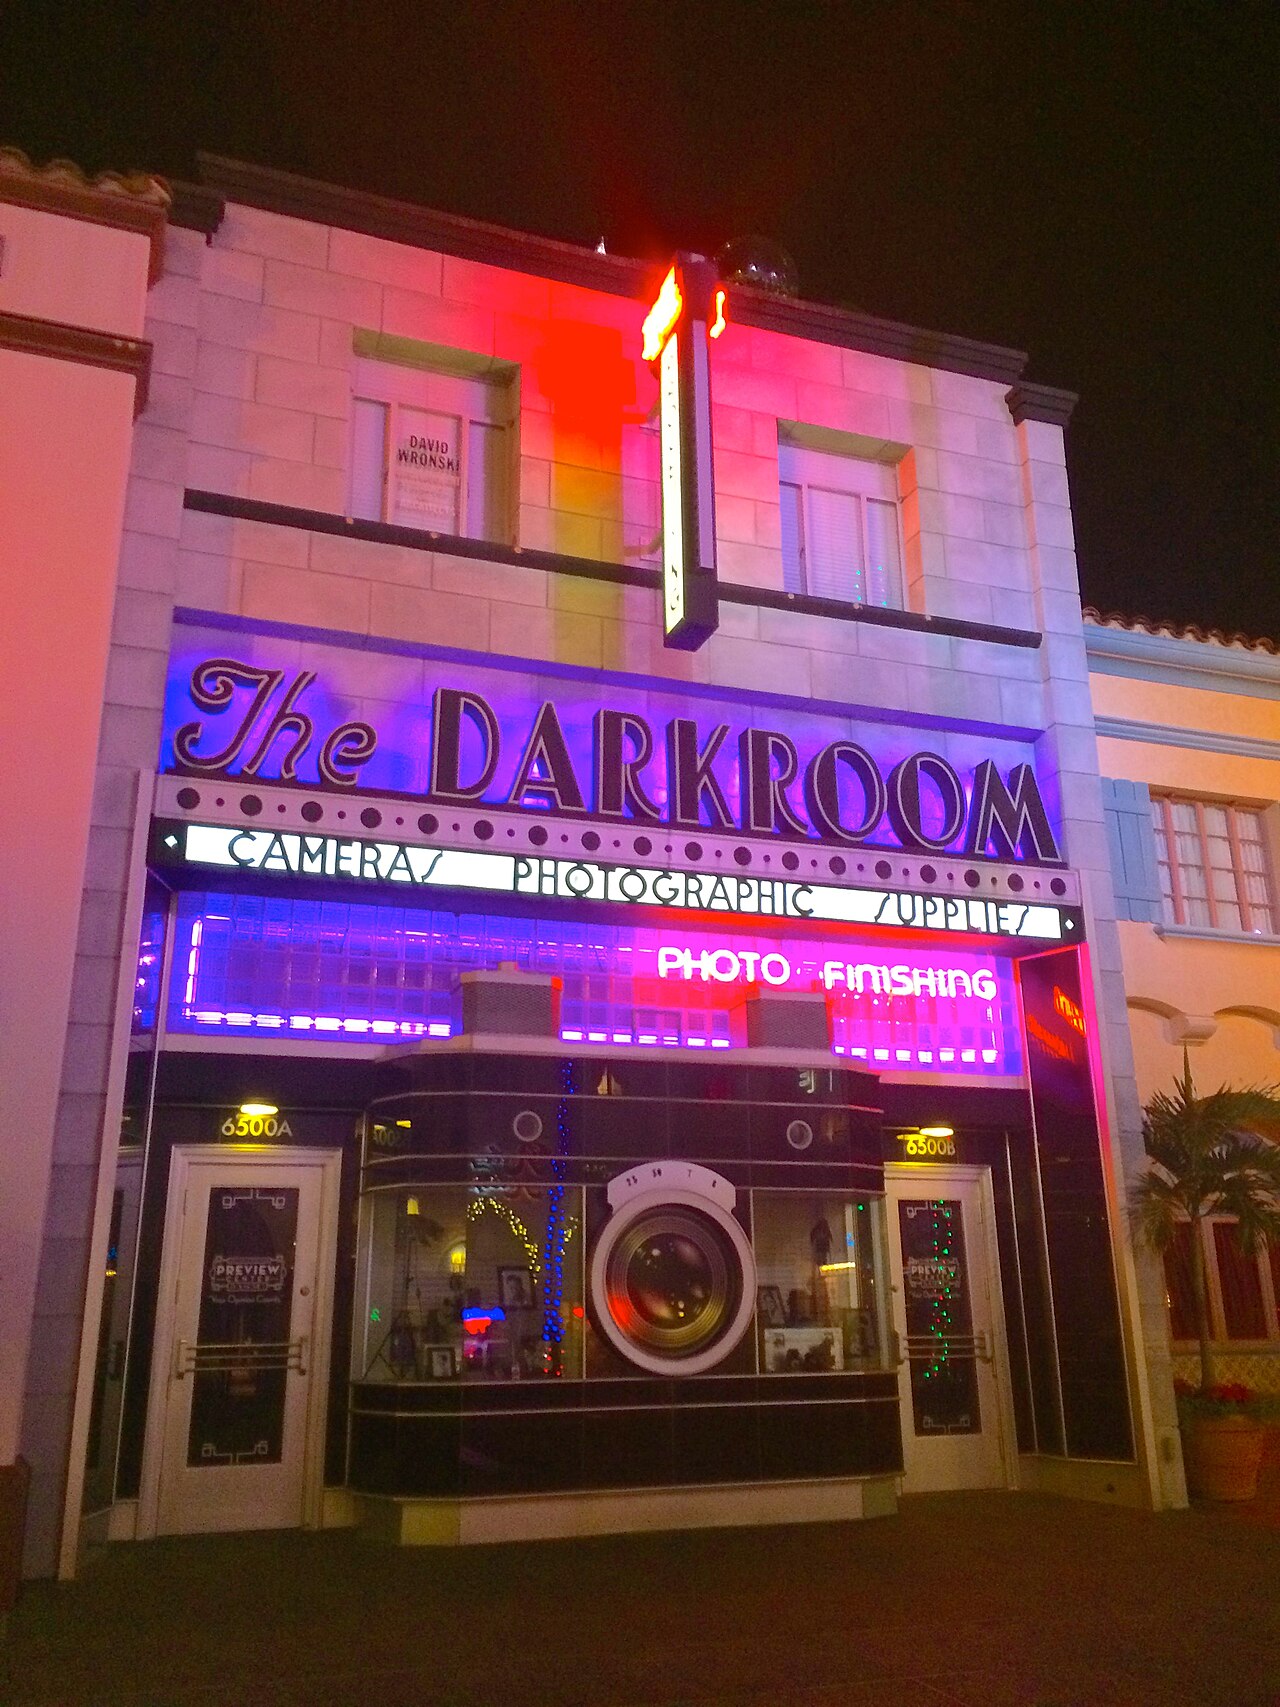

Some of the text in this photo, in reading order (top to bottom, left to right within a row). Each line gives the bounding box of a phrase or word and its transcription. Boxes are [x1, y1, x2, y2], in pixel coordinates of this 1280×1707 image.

[409, 435, 449, 454] DAVID
[398, 448, 460, 471] WRONSKI
[173, 658, 1064, 862] The DARKROOM
[228, 831, 1029, 935] CAMERAS PHOTOGRAPHIC SUPPLIES
[657, 945, 791, 985] PHOTO
[221, 1117, 293, 1137] 6500A
[906, 1138, 955, 1157] 6500B
[216, 1265, 280, 1276] PREVIEW
